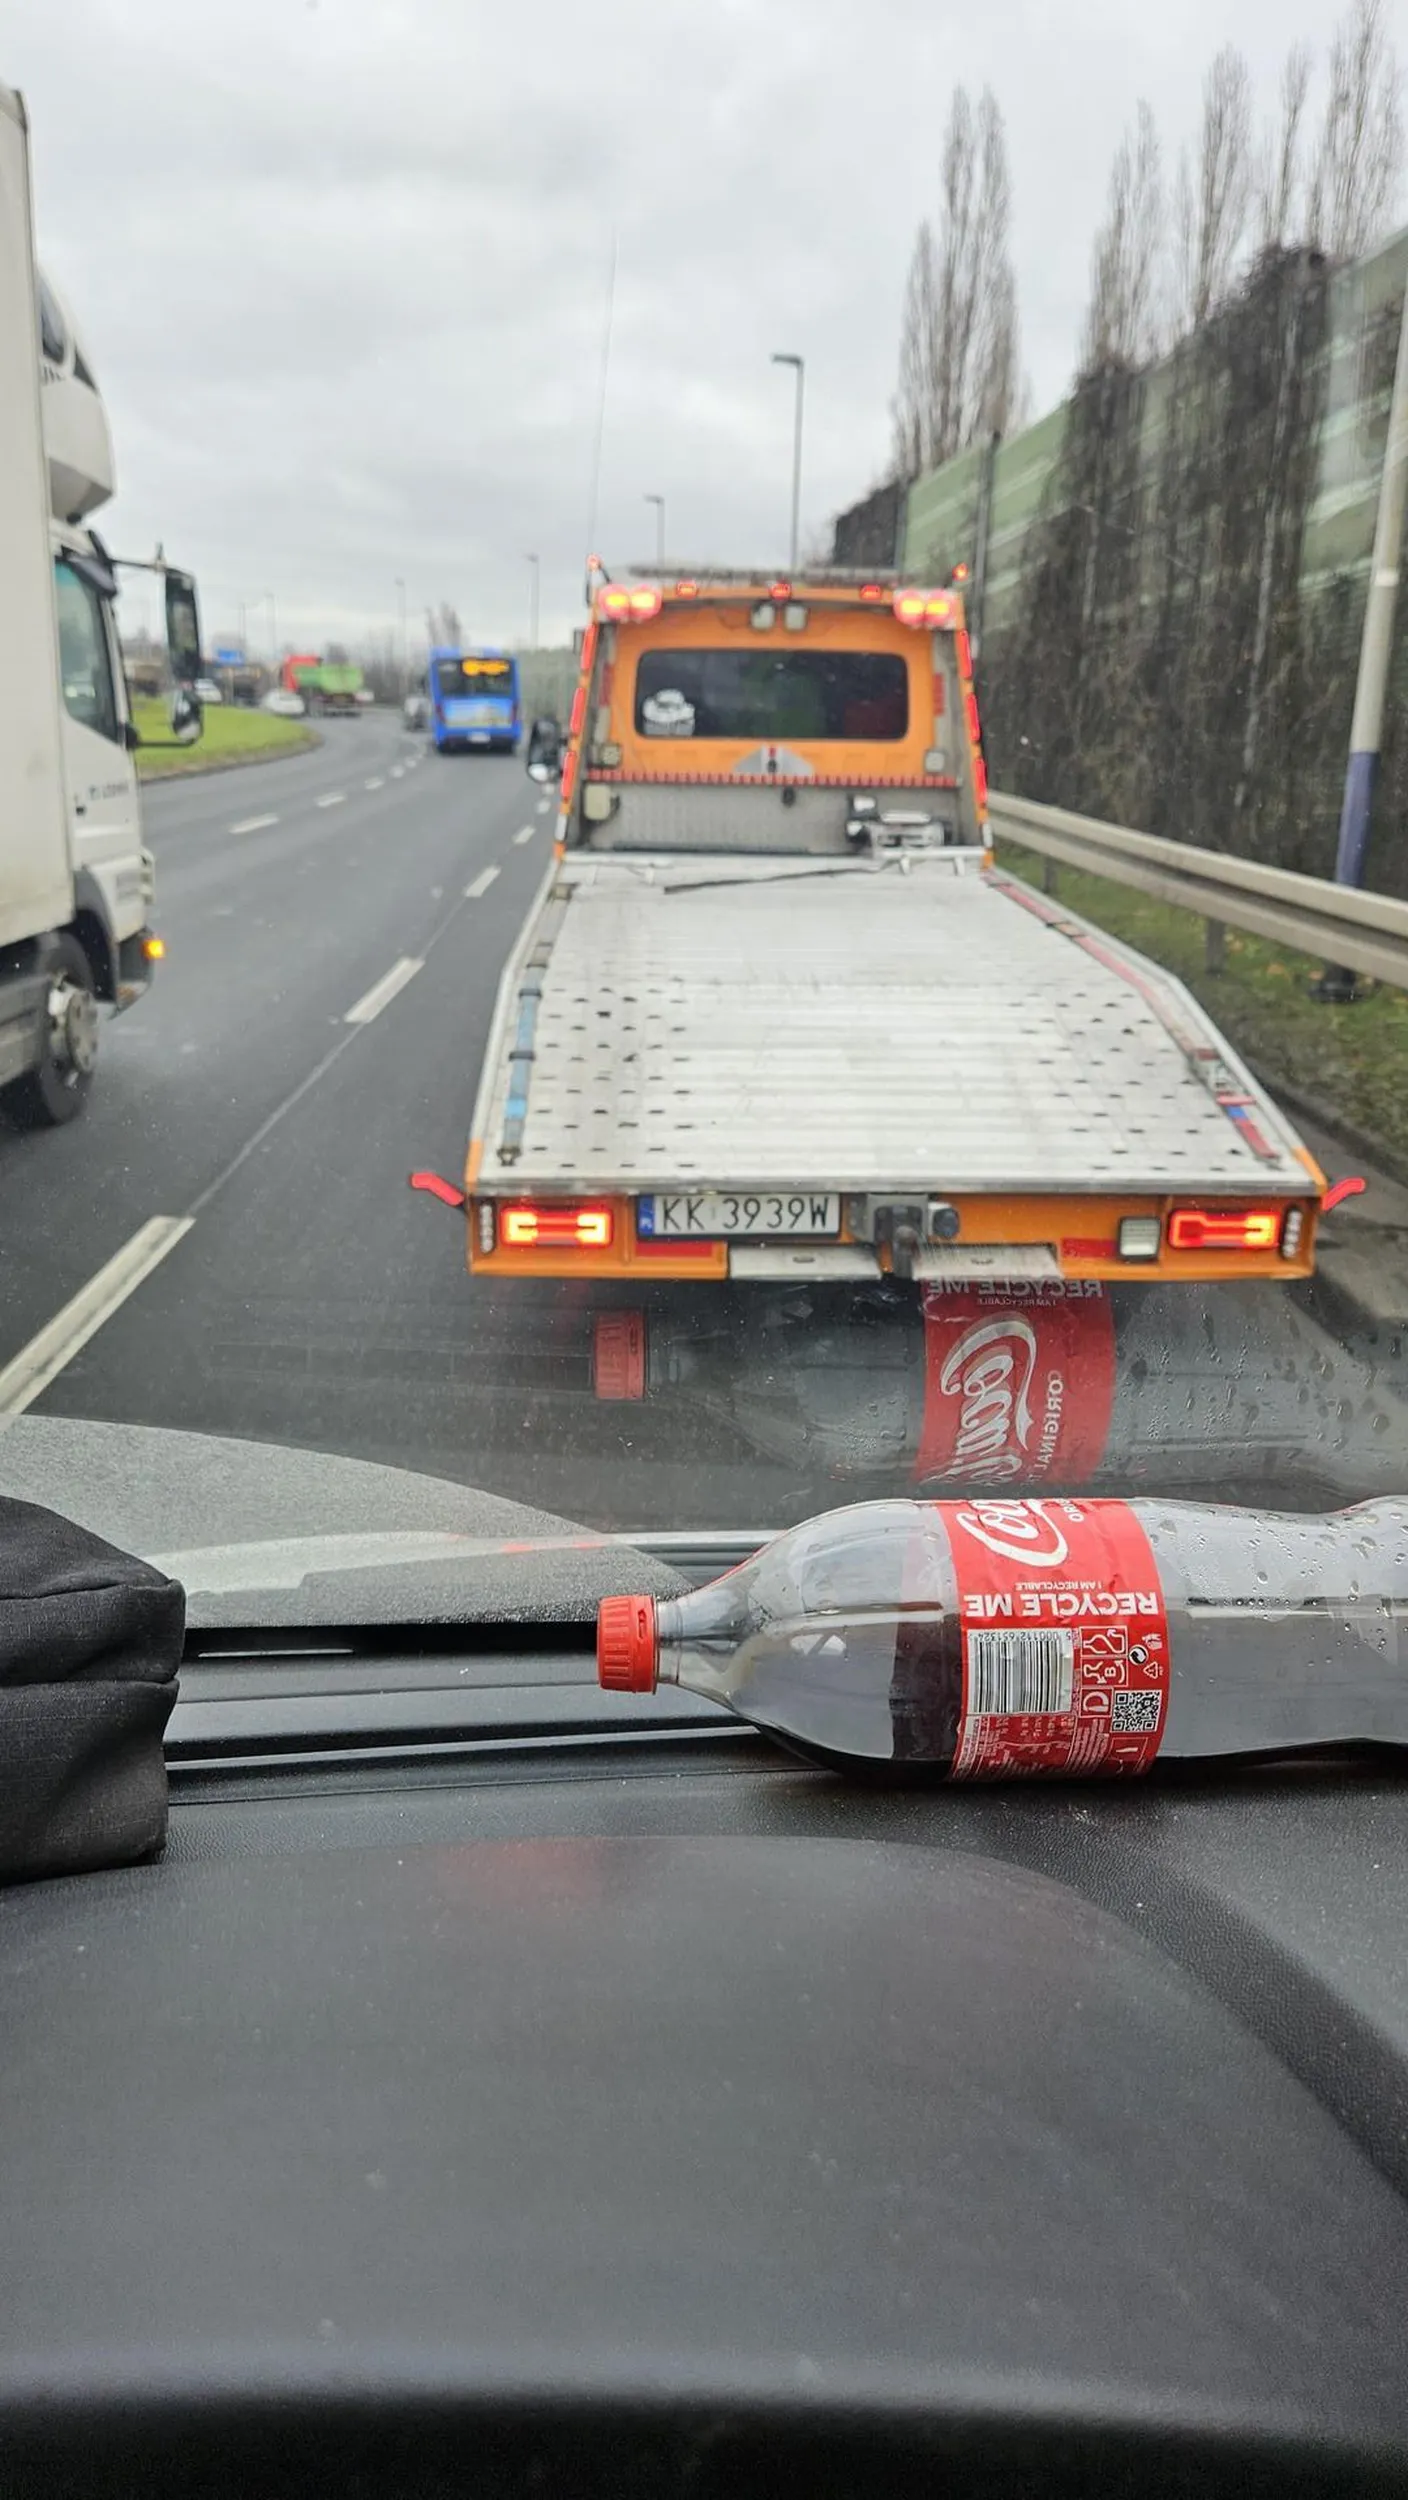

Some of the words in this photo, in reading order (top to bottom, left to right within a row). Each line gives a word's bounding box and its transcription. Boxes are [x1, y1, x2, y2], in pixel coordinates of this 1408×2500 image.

[663, 1197, 704, 1231] KK
[722, 1197, 829, 1230] 3939W
[1015, 1580, 1079, 1590] RECYCLABLE
[1080, 1581, 1097, 1589] AM
[964, 1594, 1013, 1618] ME
[1016, 1592, 1159, 1617] RECYCLE
